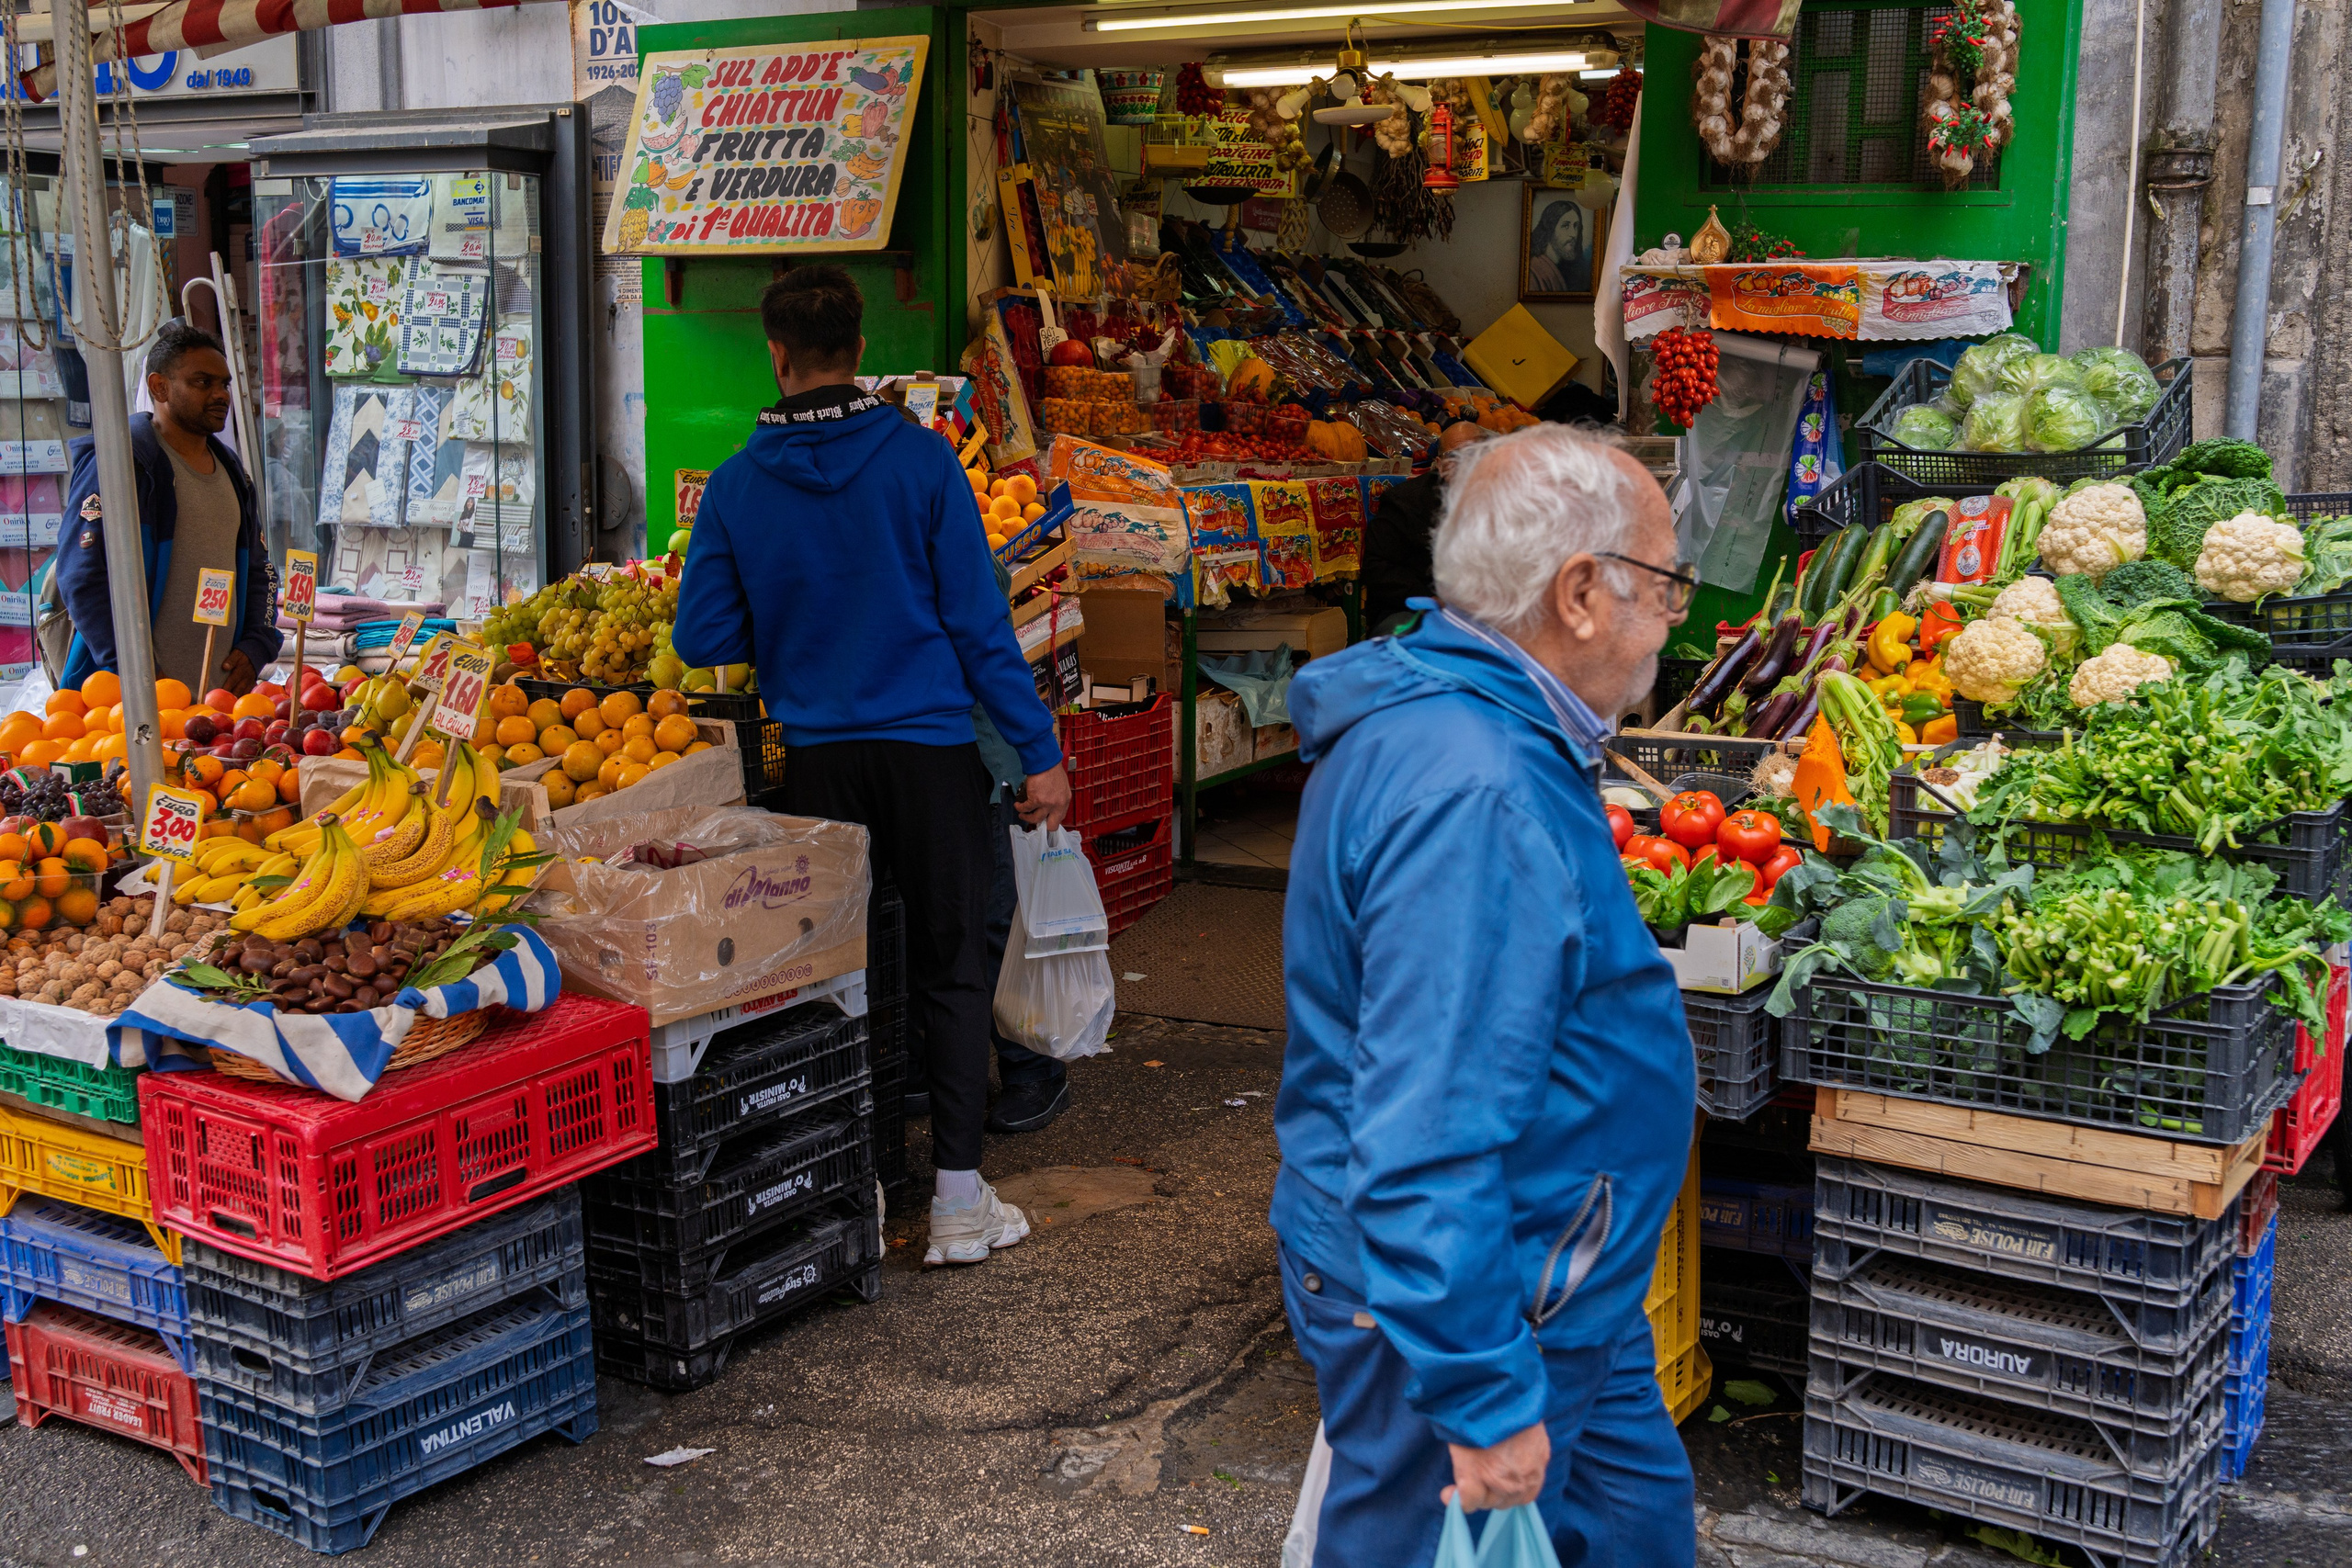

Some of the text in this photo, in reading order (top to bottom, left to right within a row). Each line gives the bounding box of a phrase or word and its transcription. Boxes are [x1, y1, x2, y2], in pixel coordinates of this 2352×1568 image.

[187, 68, 253, 88] dal 1949
[586, 63, 639, 80] 1926-202
[707, 59, 756, 89] SUL
[701, 88, 844, 128] CHIATTUN
[691, 127, 826, 163] FRUTTA
[1213, 147, 1275, 160] ORIGINE
[685, 164, 838, 201] E VERDURA
[1205, 176, 1286, 190] SELEZIONATA
[452, 197, 486, 207] BANCOMAT
[467, 217, 484, 226] VISA
[1738, 298, 1855, 321] La migliore Frutta
[1888, 302, 1906, 320] La
[792, 404, 843, 423] Black Paris
[849, 396, 880, 413] Black Paris
[770, 412, 788, 423] Black
[683, 474, 708, 486] EURO
[678, 485, 703, 515] 1,6
[292, 558, 314, 576] EURO
[205, 577, 226, 590] EURO
[286, 572, 313, 605] 1,50
[1, 594, 27, 604] Onirika
[198, 587, 229, 612] 2,50
[297, 604, 311, 616] 500
[453, 653, 491, 675] EURO
[1055, 652, 1078, 677] ANANAS
[434, 712, 471, 739] AL CHILO
[155, 795, 197, 817] EURO
[150, 807, 197, 846] 3,00
[1105, 860, 1131, 875] VISCONTI
[742, 987, 797, 1014] STRAVATO
[749, 1082, 786, 1105] MINISTR
[756, 1091, 791, 1110] OASI FRUTTA
[755, 1179, 793, 1204] MINISTR
[763, 1188, 797, 1208] OASI FRUTTA
[1969, 1227, 2025, 1255] POLISE
[84, 1274, 115, 1295] POLISE
[434, 1274, 474, 1303] POLISE
[1701, 1328, 1720, 1338] OASI
[1940, 1337, 2031, 1374] AURORA
[87, 1402, 142, 1428] LEADER FRUIT
[420, 1400, 515, 1455] VALENTINA
[1952, 1472, 2006, 1501] POLISE
